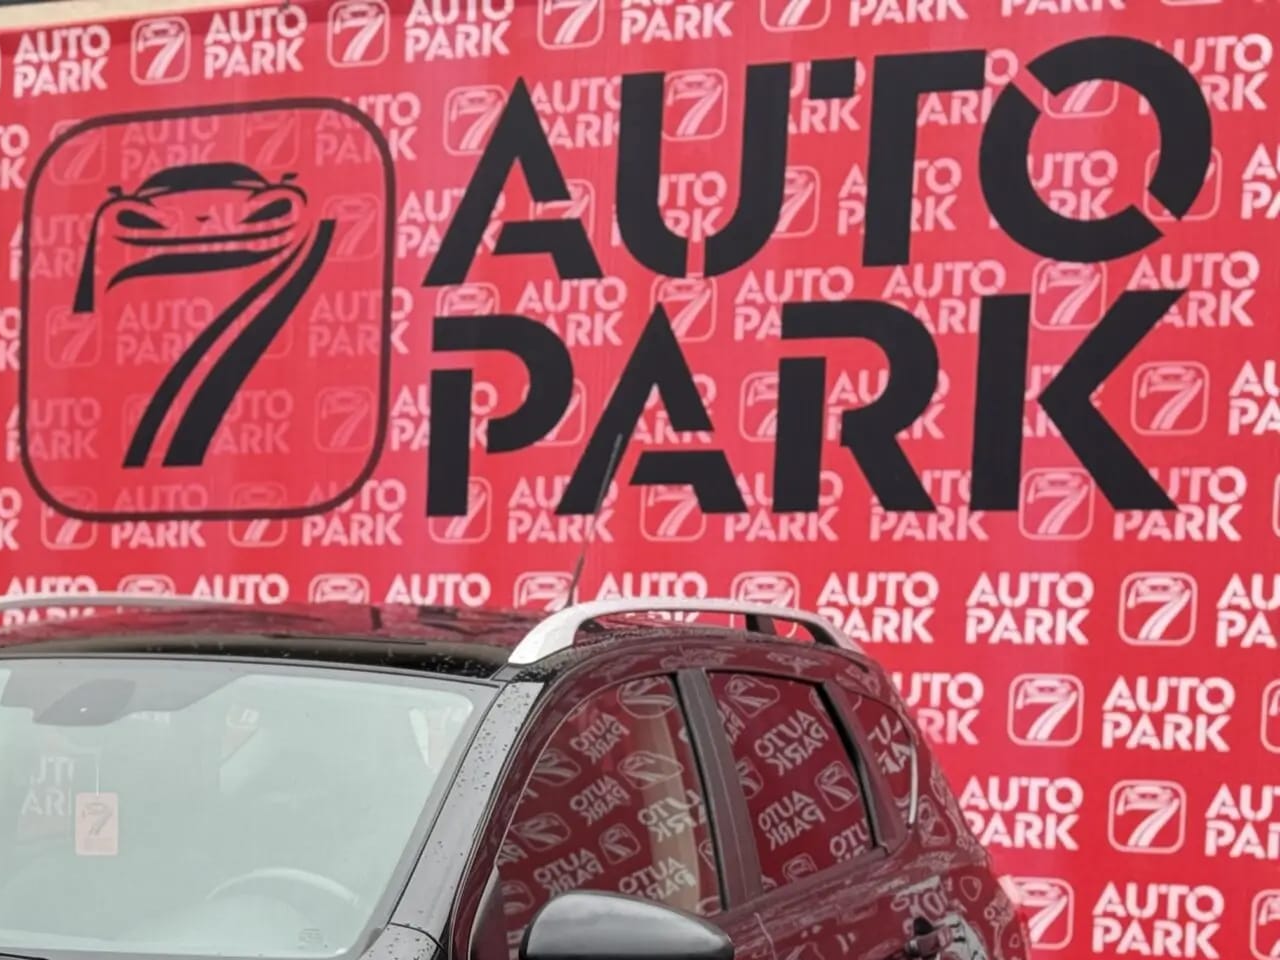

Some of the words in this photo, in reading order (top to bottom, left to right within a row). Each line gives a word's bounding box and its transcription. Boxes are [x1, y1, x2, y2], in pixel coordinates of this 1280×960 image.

[205, 7, 306, 43] AUTO
[404, 24, 510, 61] PARK
[620, 2, 732, 45] PARK
[15, 26, 110, 65] AUTO
[204, 42, 303, 78] PARK
[14, 62, 108, 97] PARK
[422, 36, 1212, 287] AUTO
[736, 267, 854, 301] AUTO
[883, 260, 1005, 299] AUTO
[1127, 252, 1259, 291] AUTO
[426, 288, 1188, 516] PARK
[303, 513, 402, 547] PARK
[192, 574, 290, 606] AUTO
[386, 574, 491, 606] AUTO
[818, 572, 940, 607] AUTO
[966, 572, 1094, 609] AUTO
[965, 606, 1089, 646] PARK
[1103, 675, 1235, 714] AUTO
[1102, 713, 1230, 752] PARK
[959, 776, 1083, 814] AUTO
[1092, 882, 1225, 922] AUTO
[1092, 919, 1221, 959] PARK
